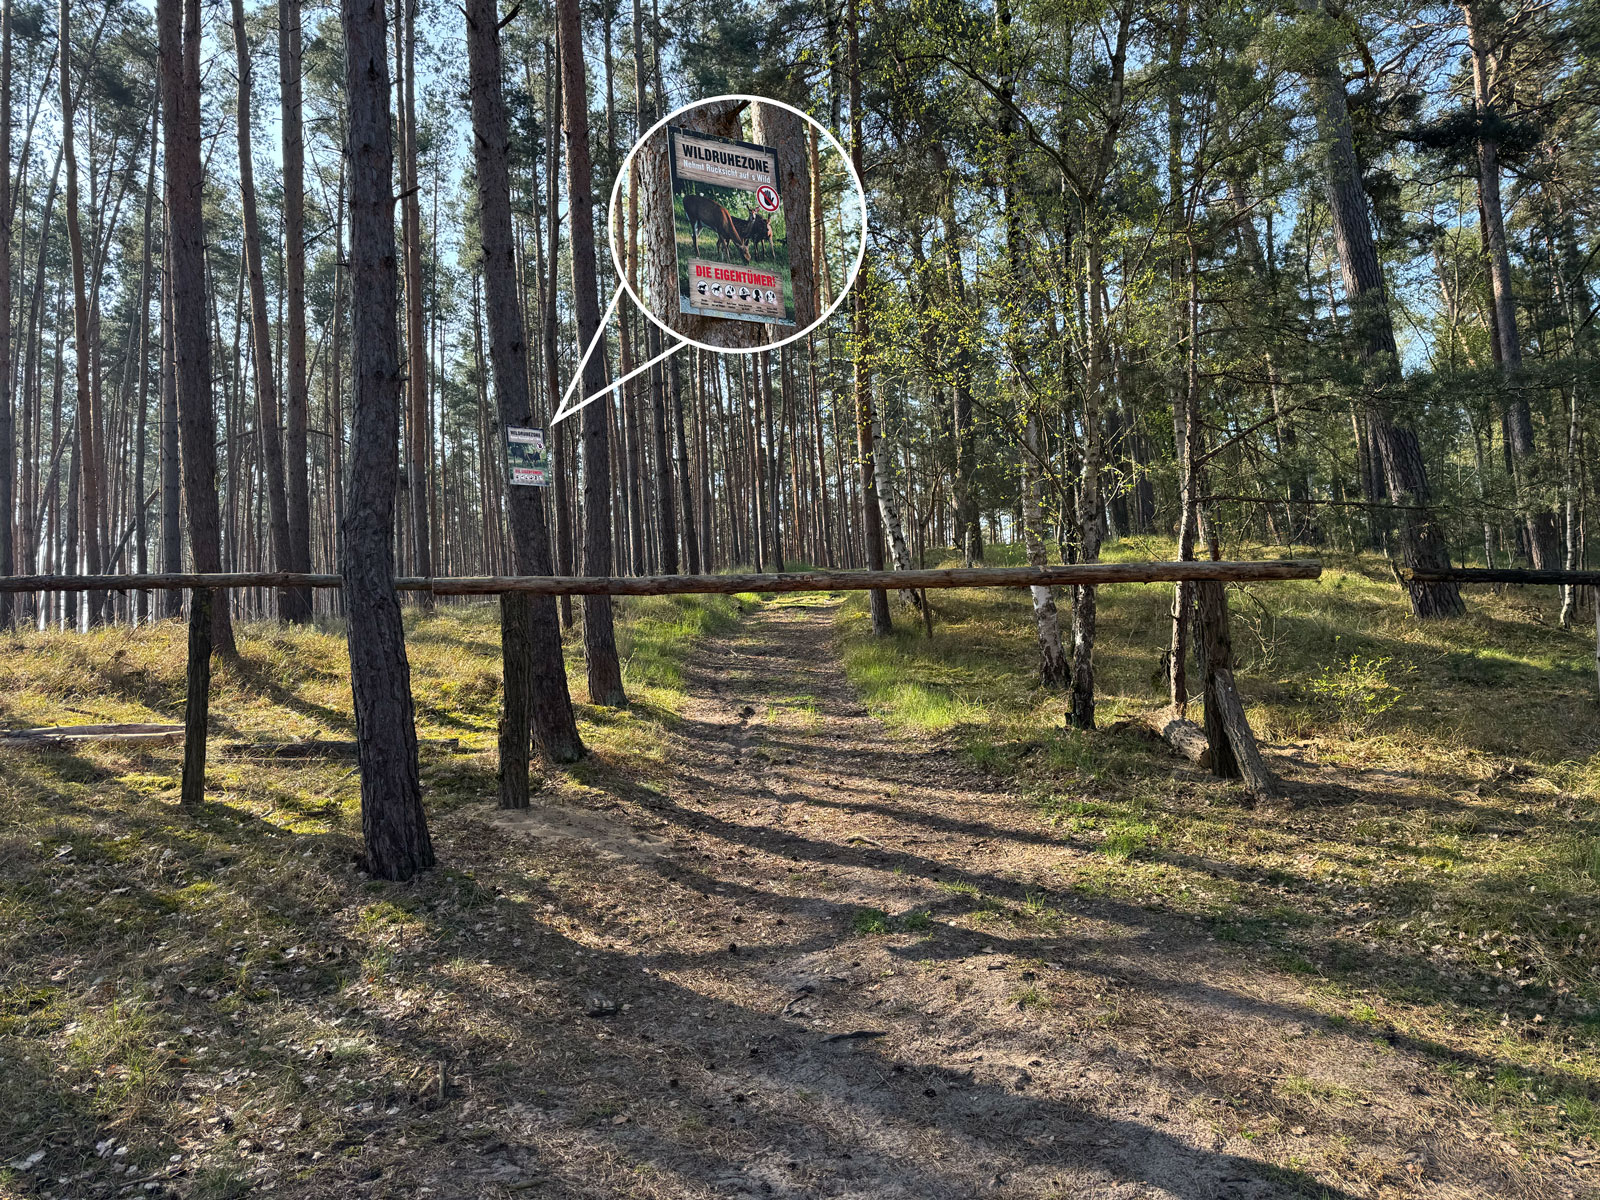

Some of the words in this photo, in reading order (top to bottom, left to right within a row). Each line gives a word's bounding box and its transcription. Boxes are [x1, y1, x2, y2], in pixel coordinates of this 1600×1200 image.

[682, 144, 770, 173] WILDRUHEZONE
[683, 160, 705, 171] Nehmt
[739, 172, 750, 180] auf
[757, 173, 771, 184] Wild
[696, 265, 712, 278] DIE
[714, 268, 776, 287] EIGENTÜMER!
